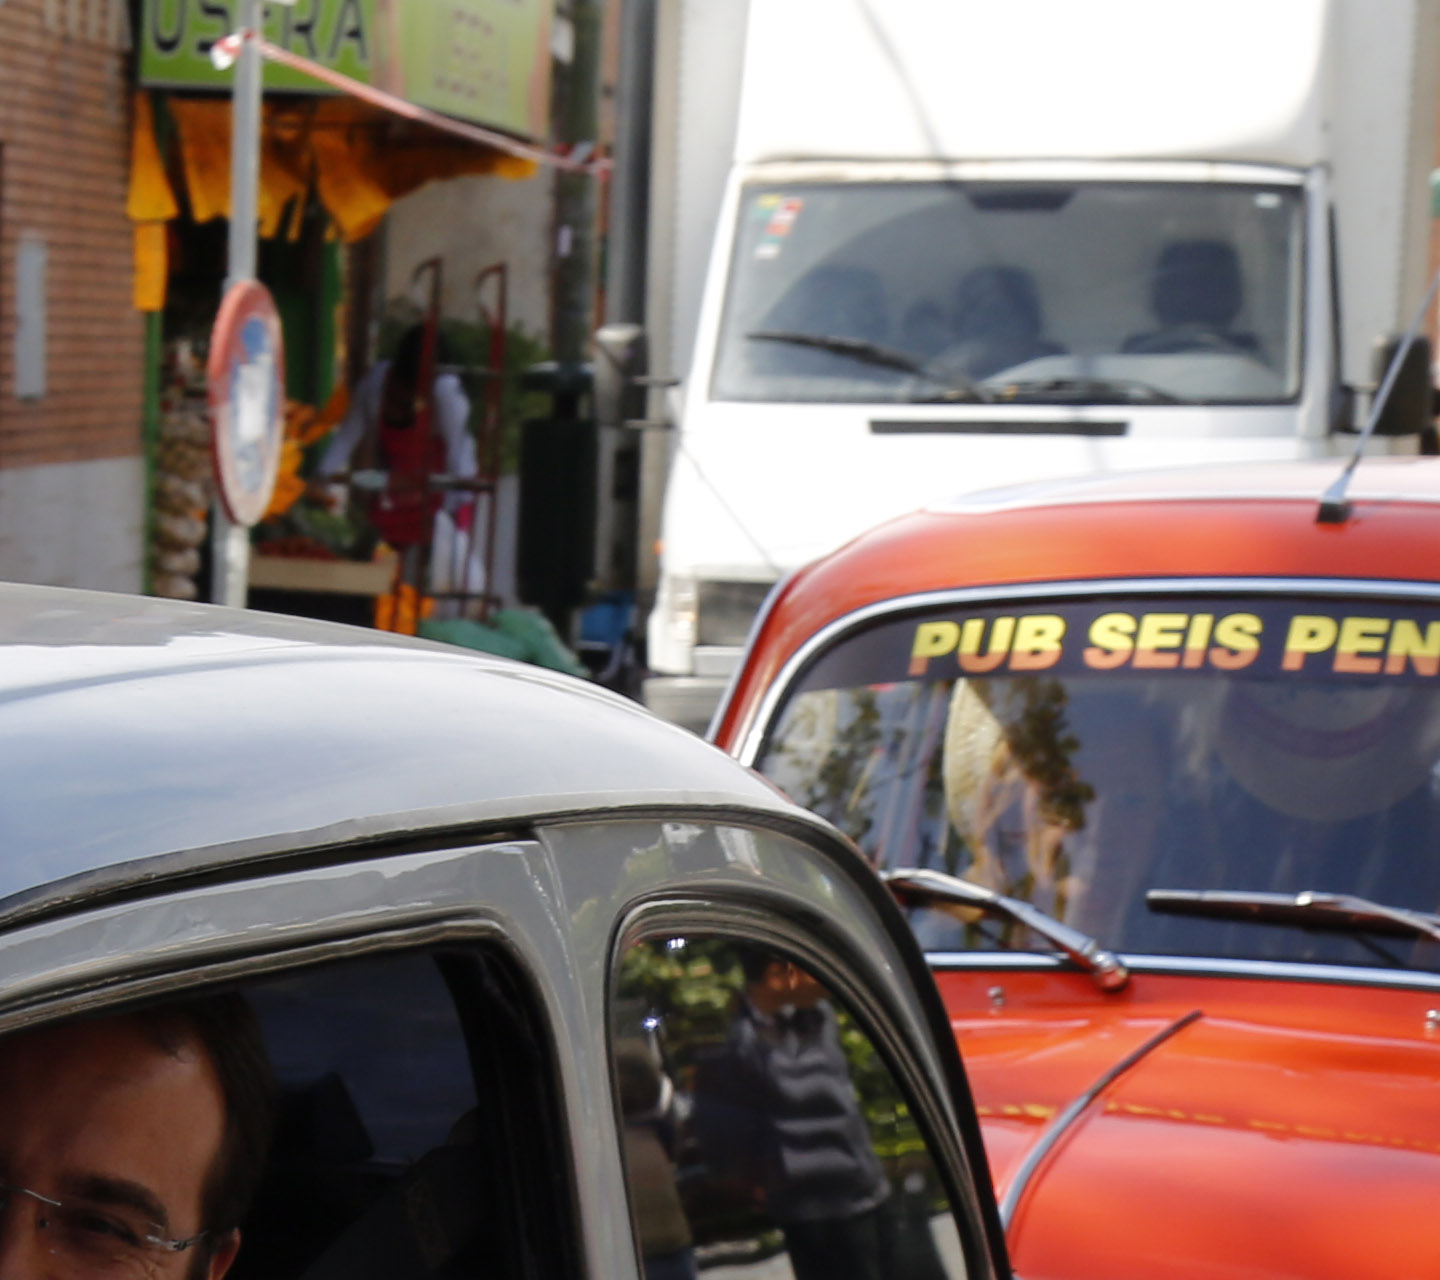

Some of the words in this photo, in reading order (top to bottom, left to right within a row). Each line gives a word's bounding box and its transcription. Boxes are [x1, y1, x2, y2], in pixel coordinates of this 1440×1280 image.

[151, 0, 368, 62] USRA
[908, 614, 1066, 676] PUB
[1083, 612, 1263, 670] SEIS
